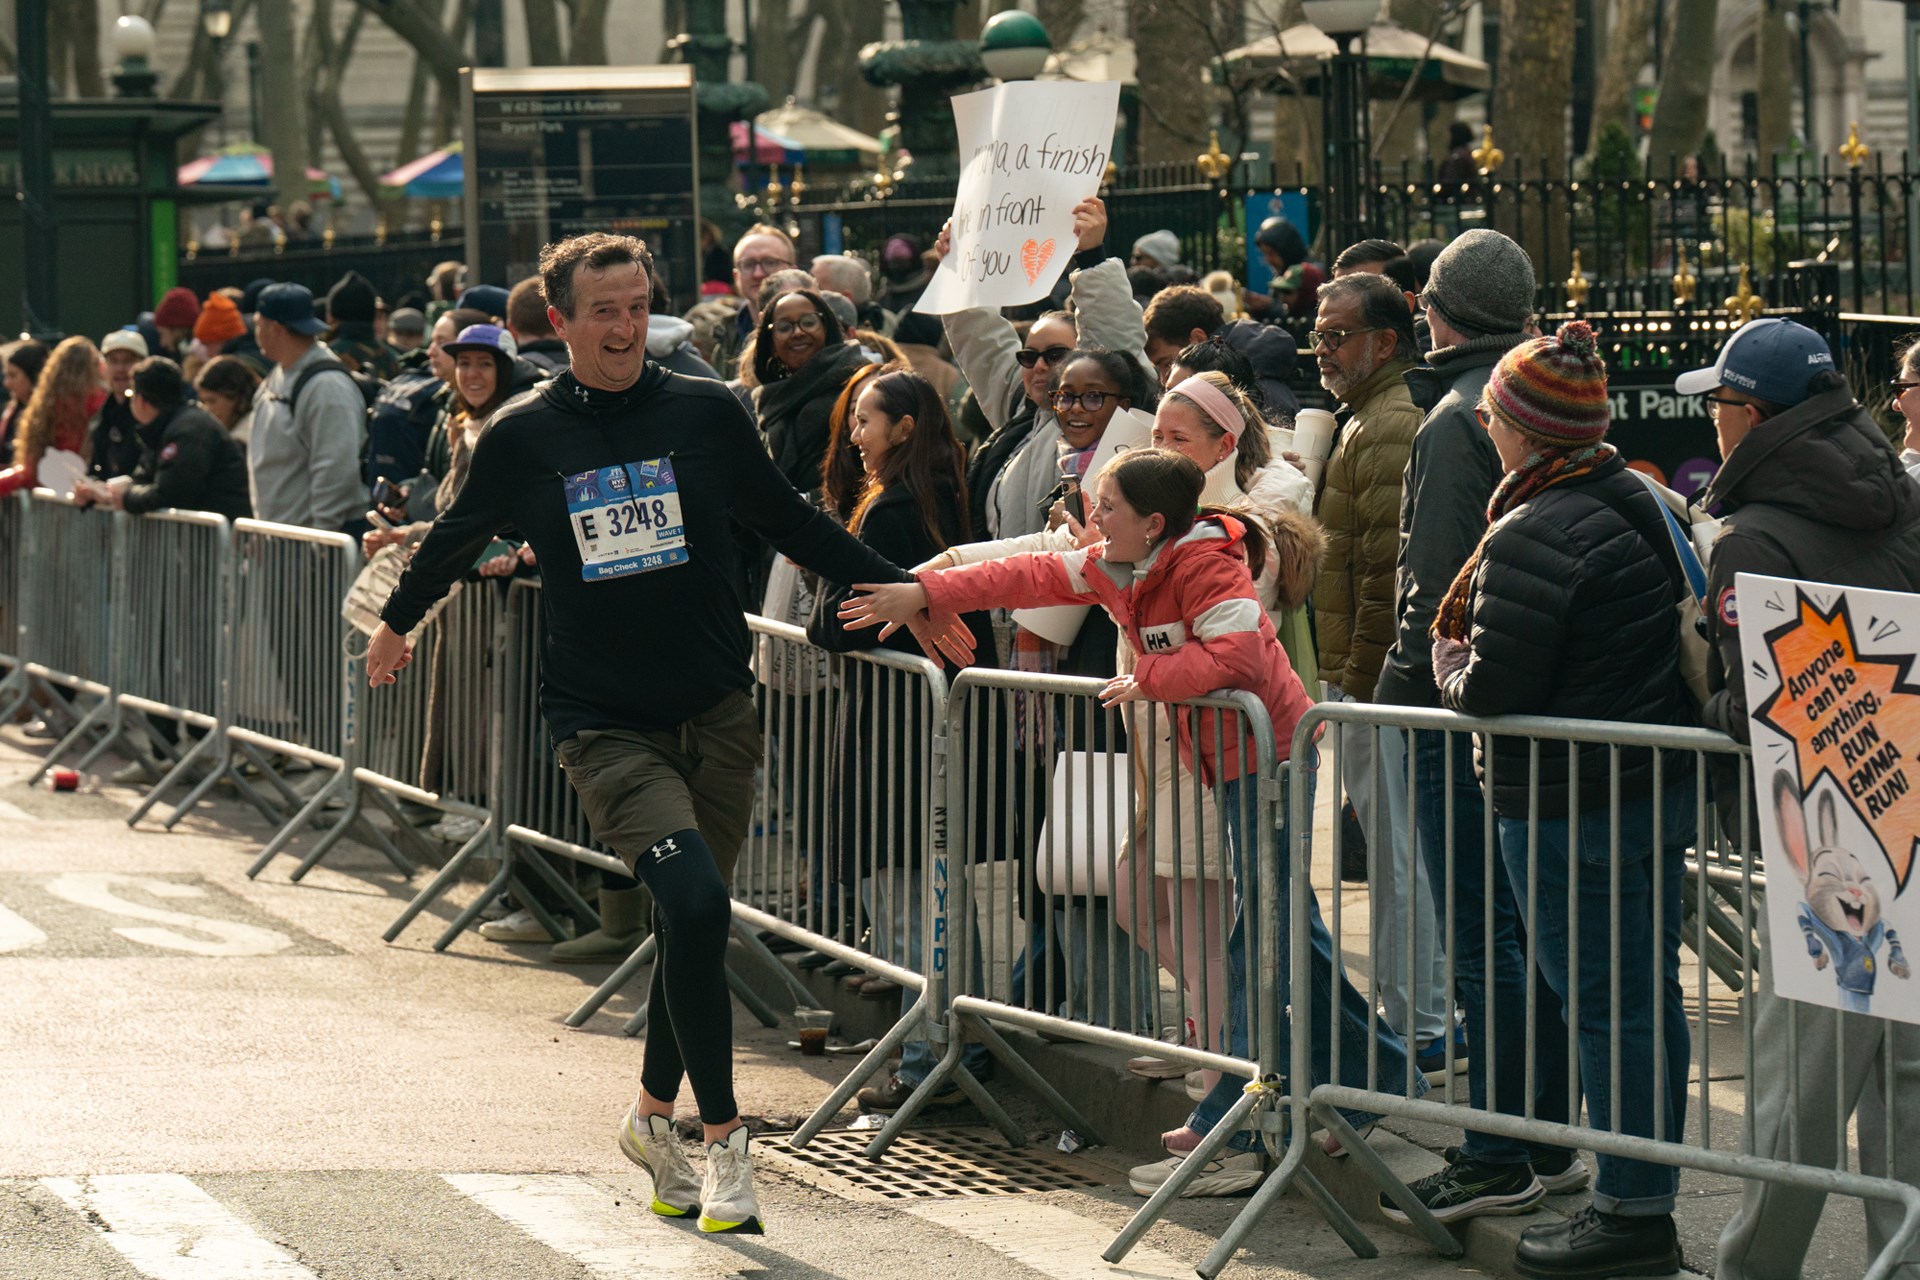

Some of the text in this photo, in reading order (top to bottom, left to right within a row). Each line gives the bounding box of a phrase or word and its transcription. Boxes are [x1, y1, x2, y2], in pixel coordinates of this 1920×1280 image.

[530, 101, 562, 113] Street
[584, 101, 622, 112] Avenue
[501, 121, 564, 135] Bryant Park
[1015, 143, 1029, 170] a
[1037, 132, 1105, 177] finish
[75, 162, 139, 185] NEWS
[996, 193, 1045, 226] front
[978, 250, 1011, 282] you
[1640, 390, 1706, 420] Park
[580, 515, 599, 540] E
[606, 499, 668, 537] 3248
[657, 529, 677, 538] WAVE
[598, 554, 663, 575] Bag Check 3248
[1146, 631, 1172, 650] HH
[1788, 640, 1845, 701] Anyone
[1806, 667, 1857, 722] can be
[1810, 690, 1883, 754] anything,
[1840, 721, 1880, 769] RUN
[1847, 740, 1903, 799] EMMA
[1864, 768, 1910, 820] RUN!
[933, 857, 948, 972] NYPD
